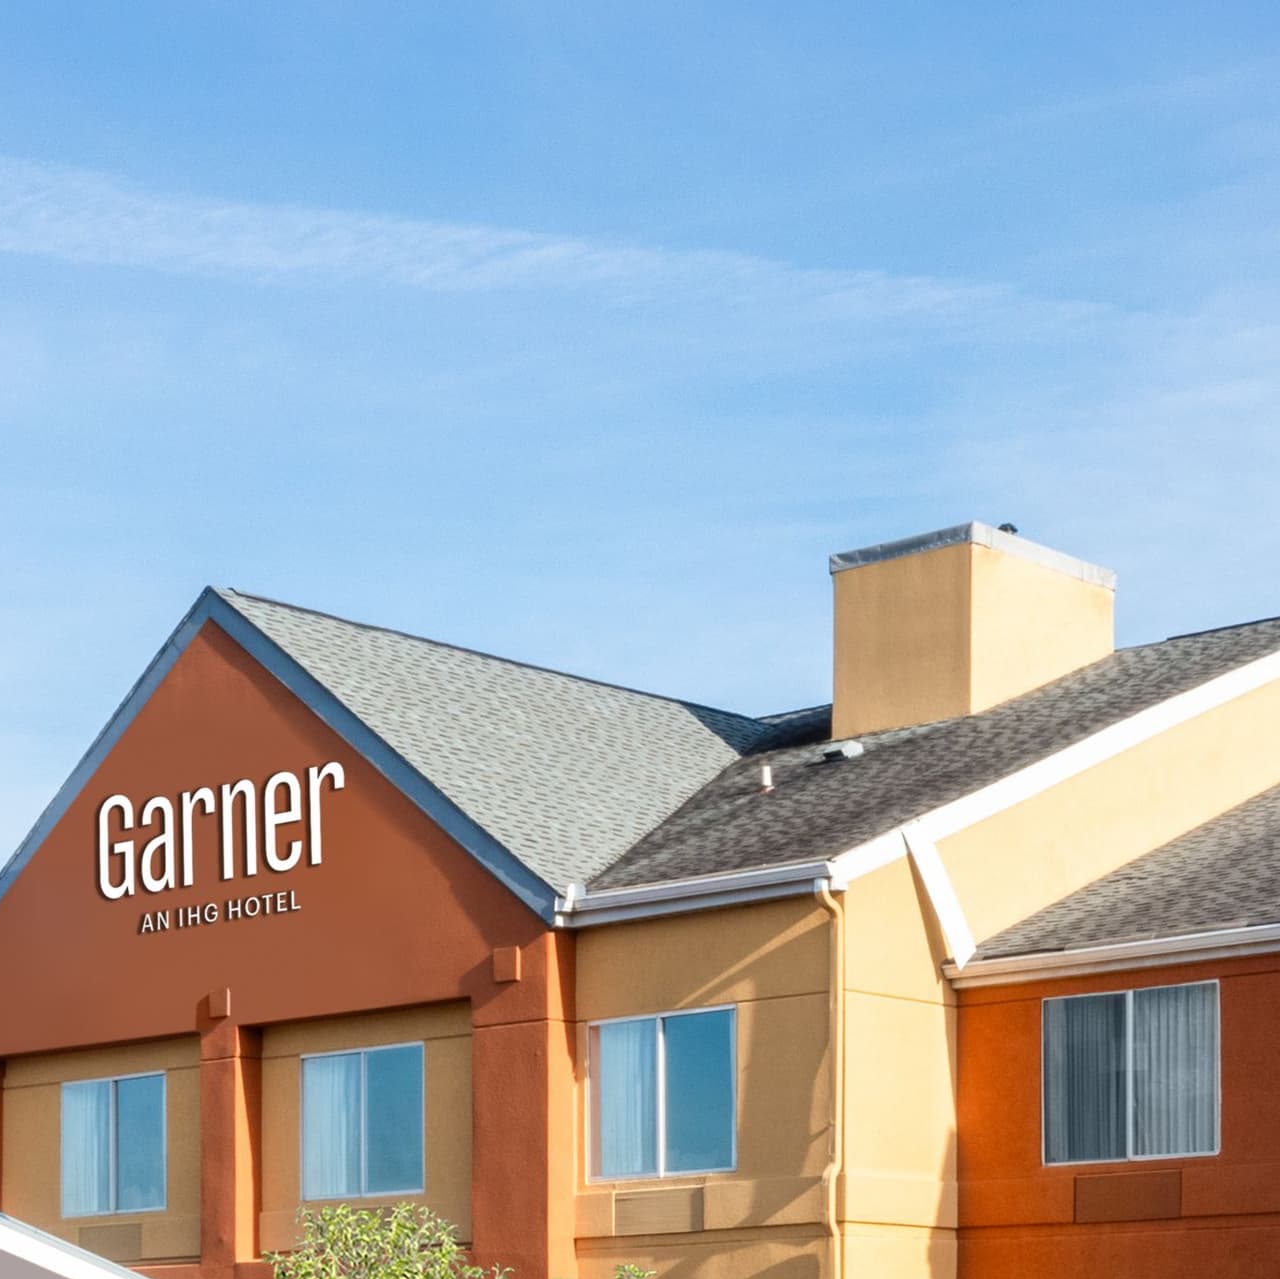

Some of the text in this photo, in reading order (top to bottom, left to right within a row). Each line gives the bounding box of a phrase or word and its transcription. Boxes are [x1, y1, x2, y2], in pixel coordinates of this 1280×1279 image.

[99, 761, 345, 900] Garner
[141, 890, 301, 933] AN IHG HOTEL
